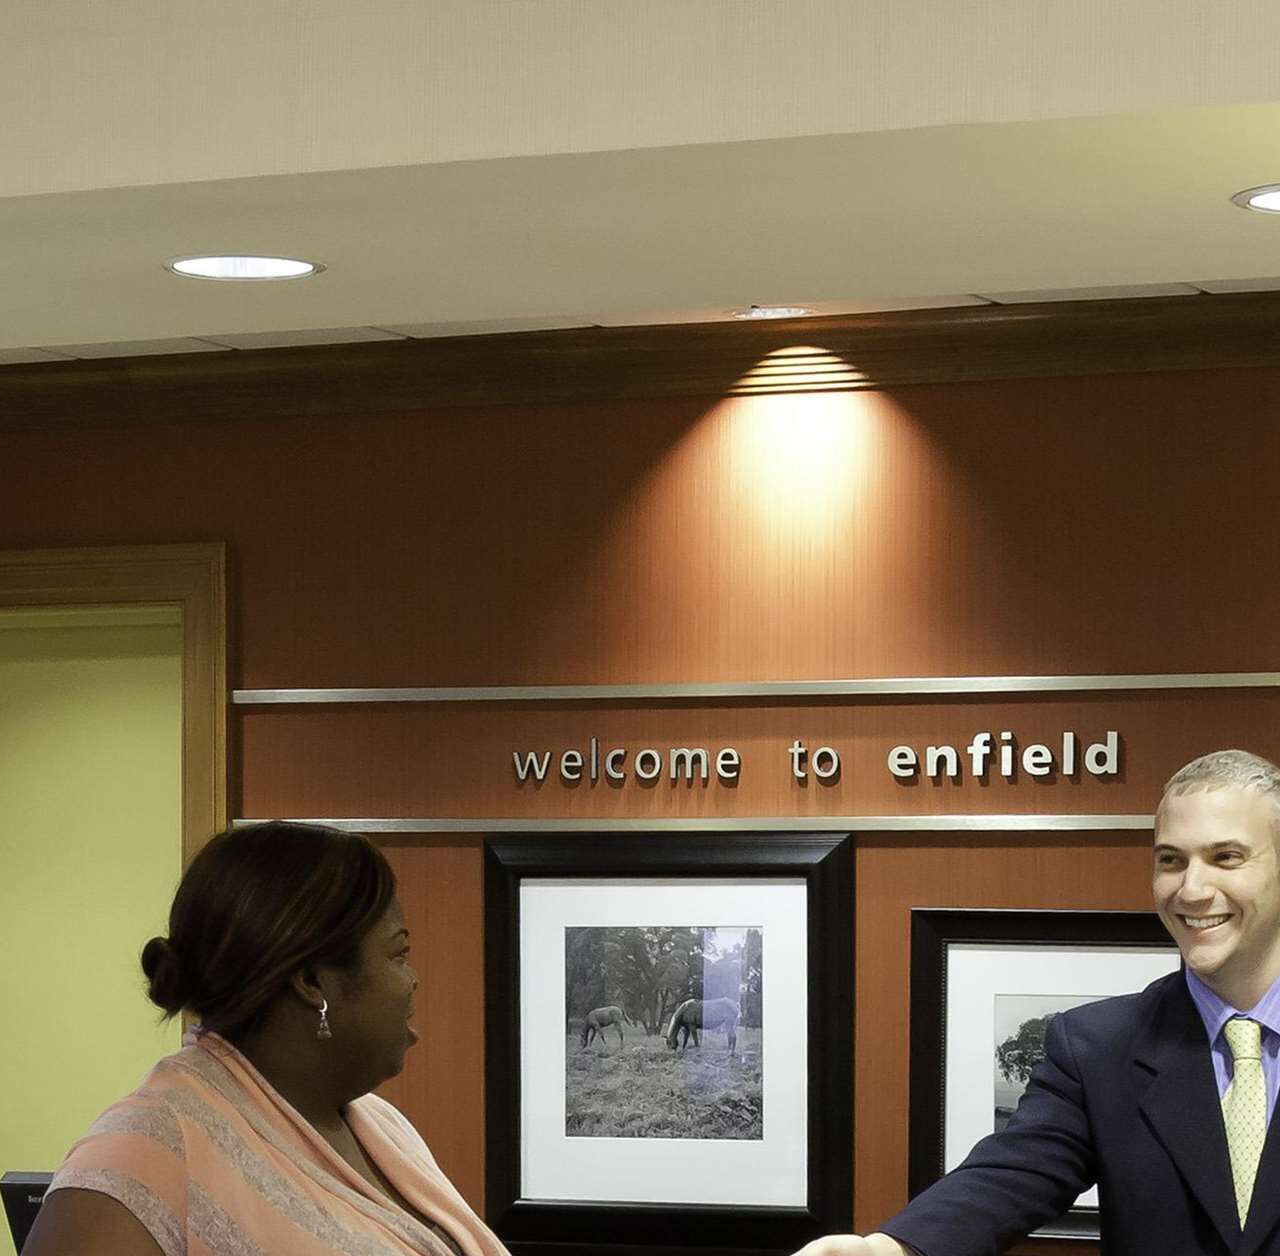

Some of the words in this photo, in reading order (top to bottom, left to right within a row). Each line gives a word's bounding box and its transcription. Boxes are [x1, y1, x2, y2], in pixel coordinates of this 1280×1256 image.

[512, 738, 742, 782] welcome
[788, 740, 841, 777] to
[887, 731, 1119, 777] enfield
